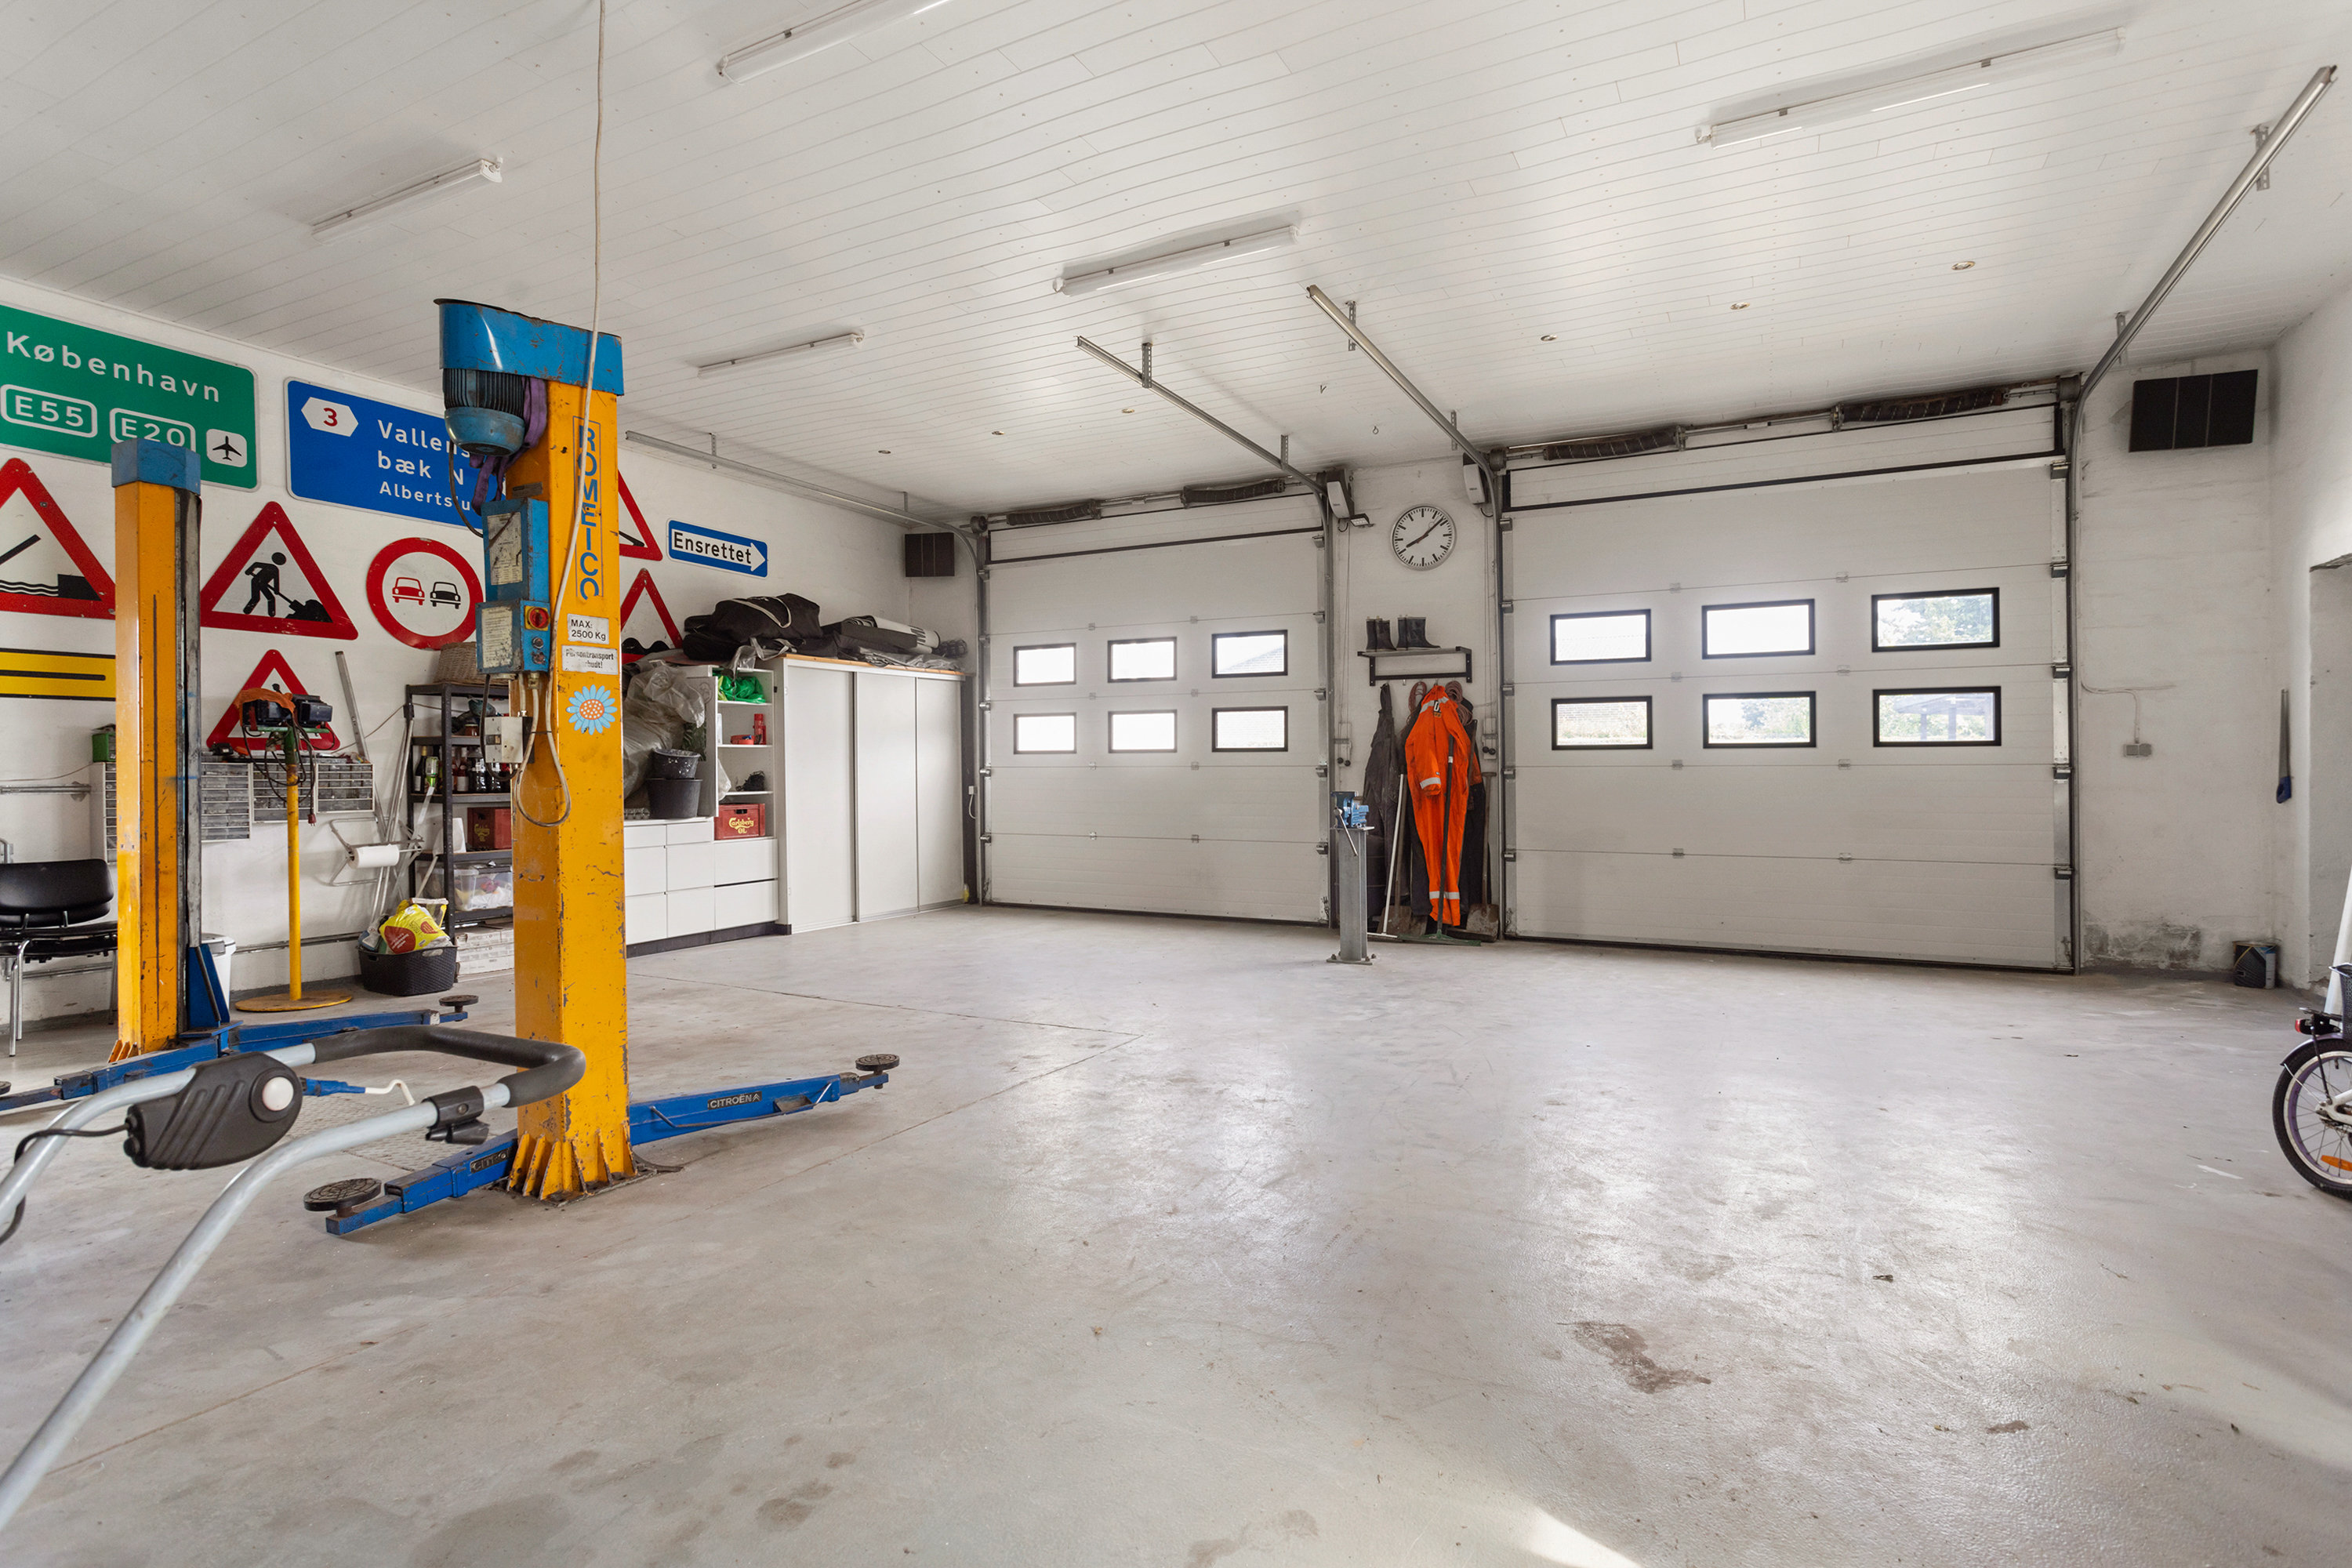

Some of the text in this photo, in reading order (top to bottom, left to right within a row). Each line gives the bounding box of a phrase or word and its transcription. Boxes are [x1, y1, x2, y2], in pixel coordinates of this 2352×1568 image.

[6, 331, 220, 403] København
[15, 394, 185, 448] E55 E20
[323, 407, 338, 427] 3
[378, 450, 464, 485] bæk N
[379, 481, 470, 511] Albertsu
[674, 531, 752, 564] Ensrettet
[571, 619, 593, 629] MAX:
[572, 629, 606, 642] 2500 Kg
[710, 1094, 752, 1109] CITROËN
